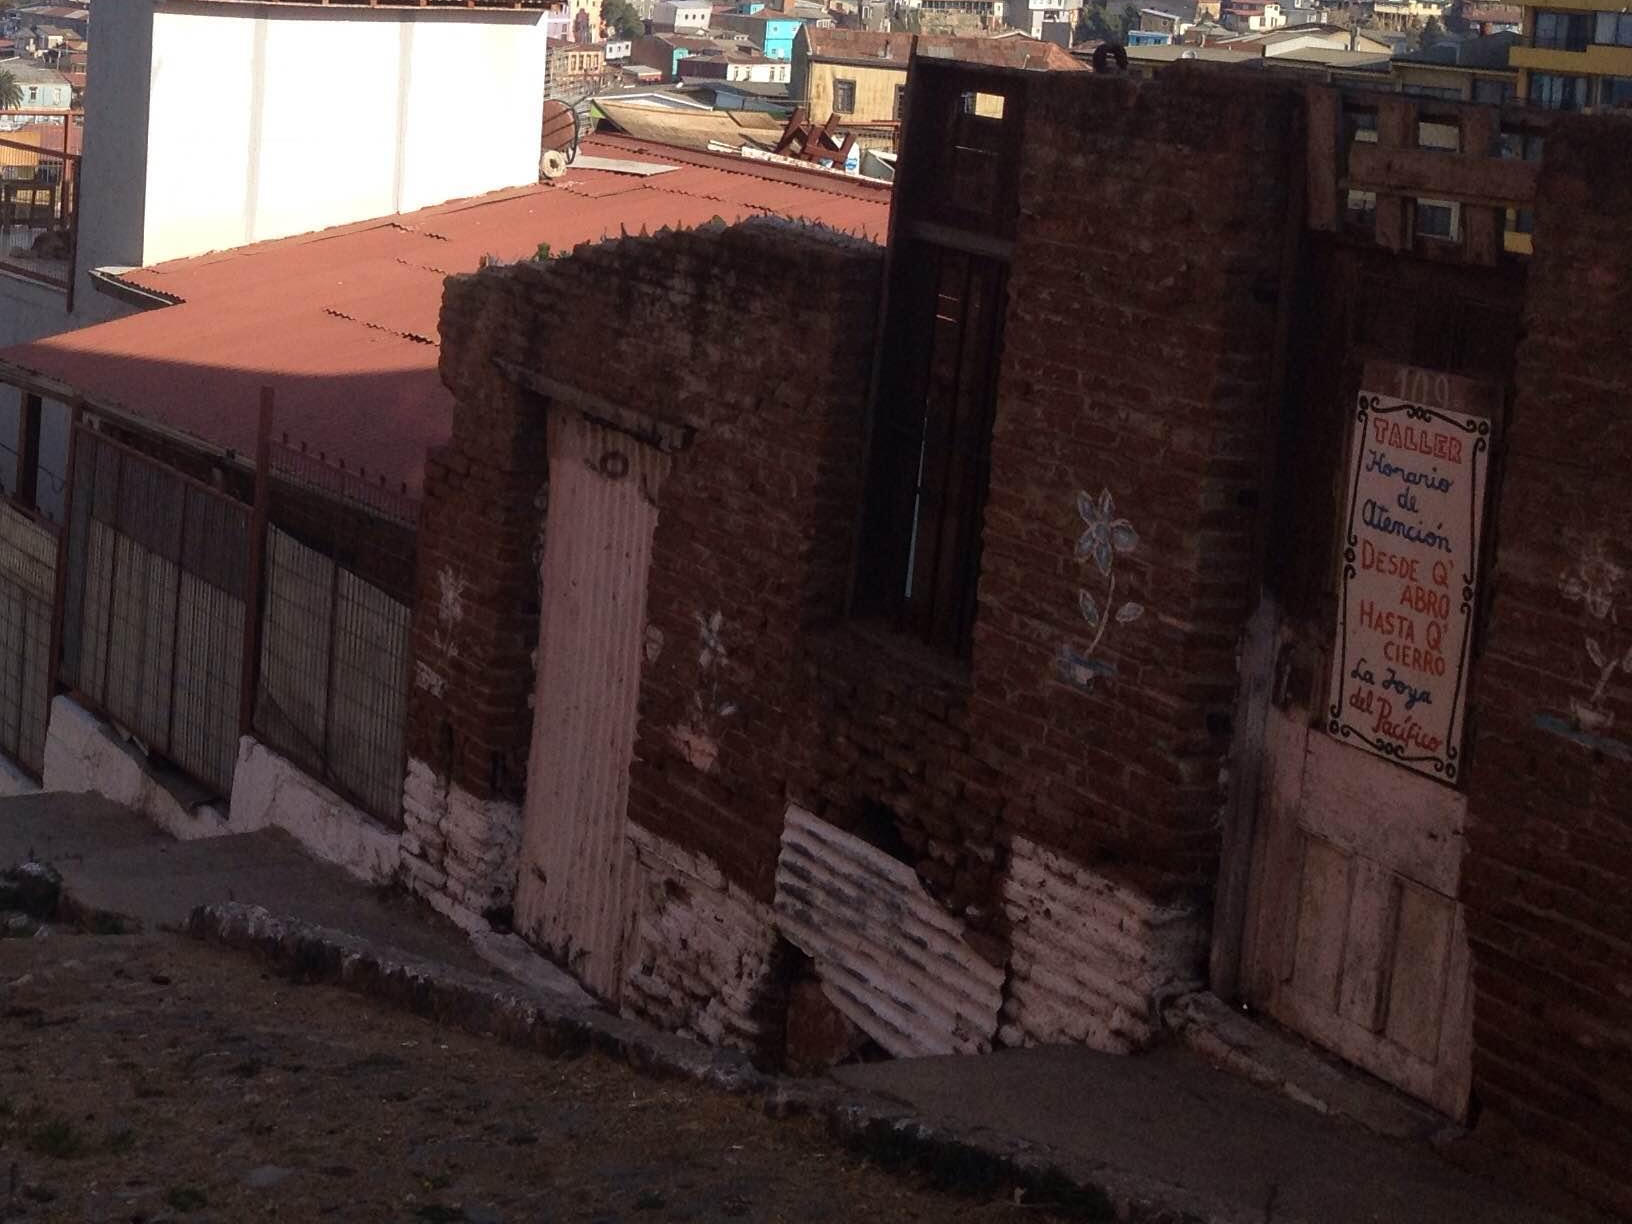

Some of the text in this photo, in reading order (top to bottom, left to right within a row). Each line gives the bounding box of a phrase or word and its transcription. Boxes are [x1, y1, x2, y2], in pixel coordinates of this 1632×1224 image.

[1372, 417, 1463, 464] TALLER
[1365, 449, 1452, 493] Horario
[1397, 486, 1419, 513] de
[1362, 499, 1452, 553] Atención
[1361, 539, 1419, 582] DESDE
[1359, 599, 1414, 643] HASTA
[1399, 584, 1450, 619] ABRO
[1383, 640, 1446, 677] CIERRO
[1350, 658, 1432, 710] La Joya
[1349, 686, 1444, 753] del Pacífico
